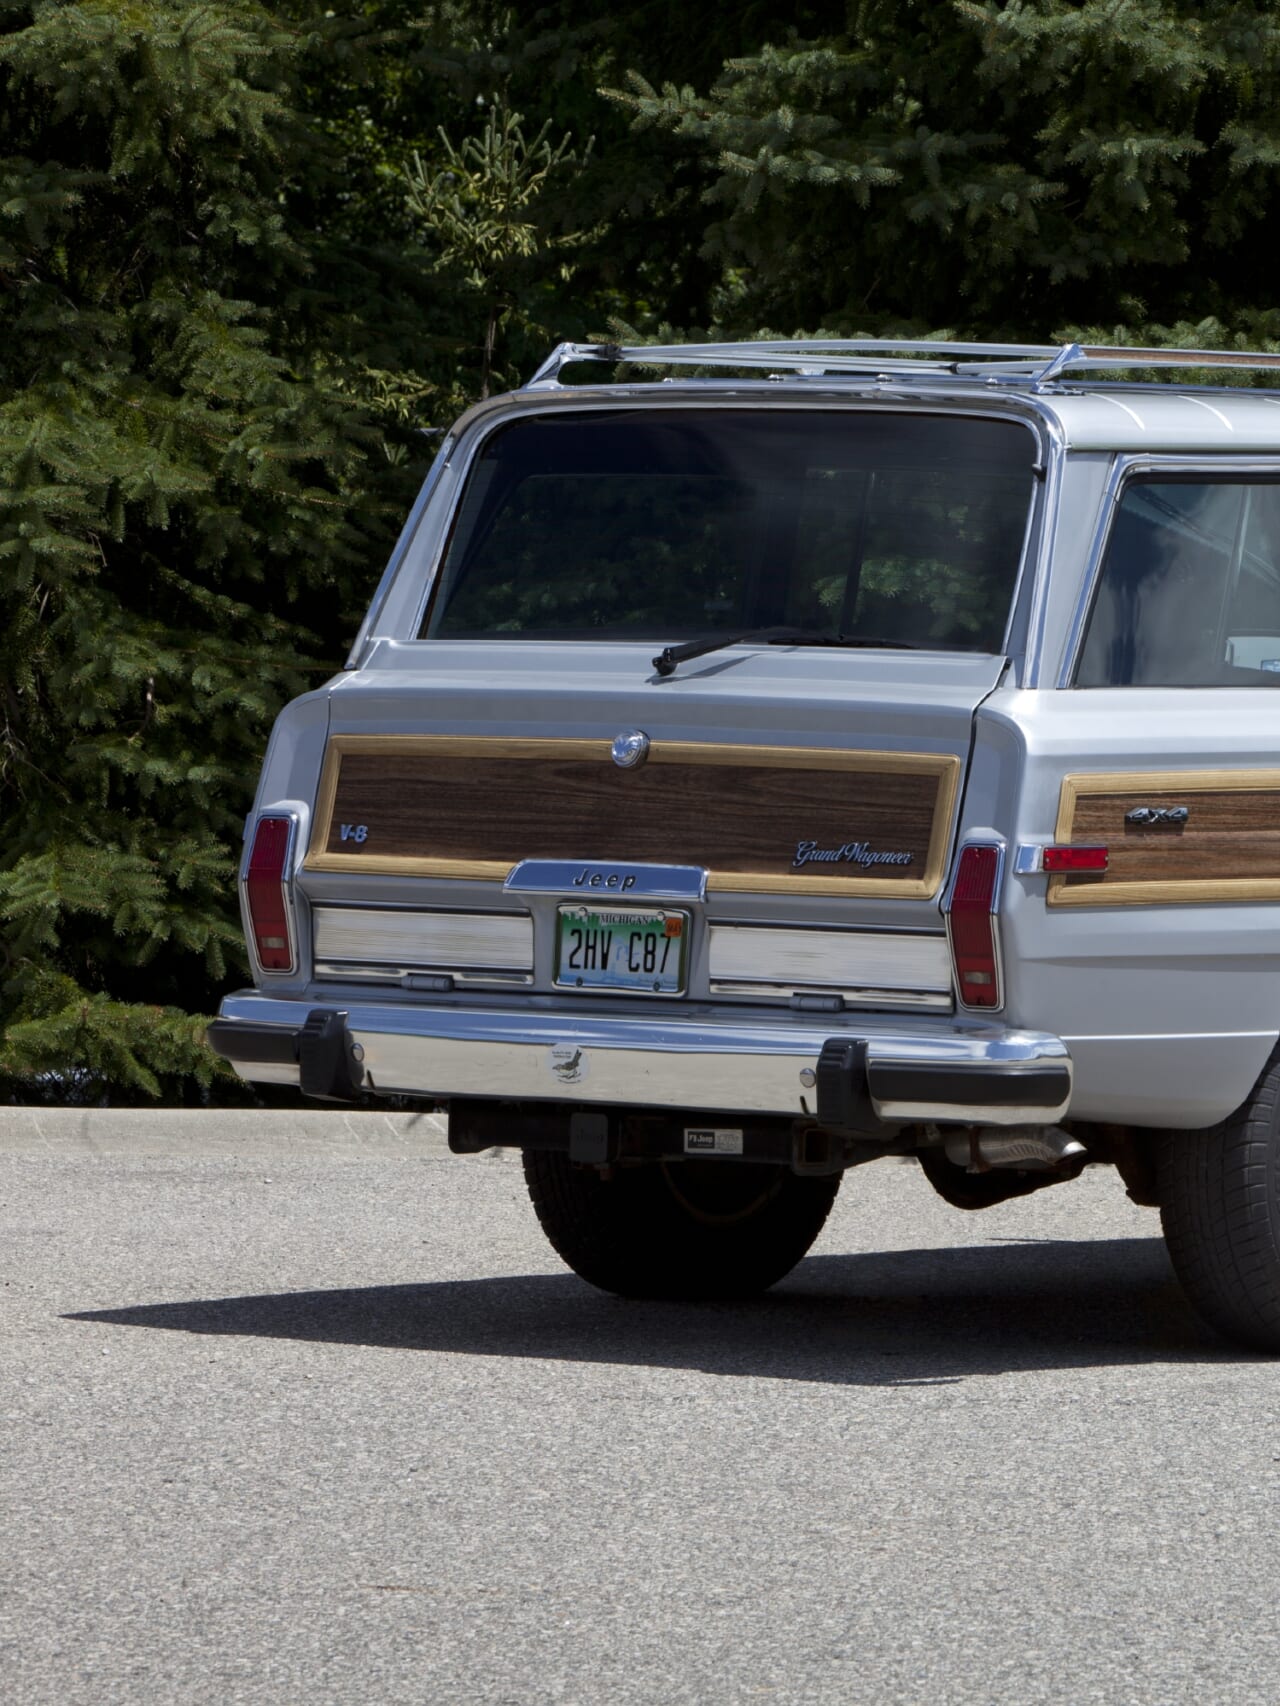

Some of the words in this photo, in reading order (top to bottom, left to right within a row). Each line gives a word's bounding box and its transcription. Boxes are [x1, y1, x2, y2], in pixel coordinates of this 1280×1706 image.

[340, 823, 369, 843] V-8
[792, 840, 846, 867] Grand
[844, 841, 914, 868] Wagoneer
[573, 868, 637, 892] Jeep
[600, 913, 650, 926] MICHIGAN
[568, 928, 613, 971] 2HV
[628, 931, 672, 974] C87
